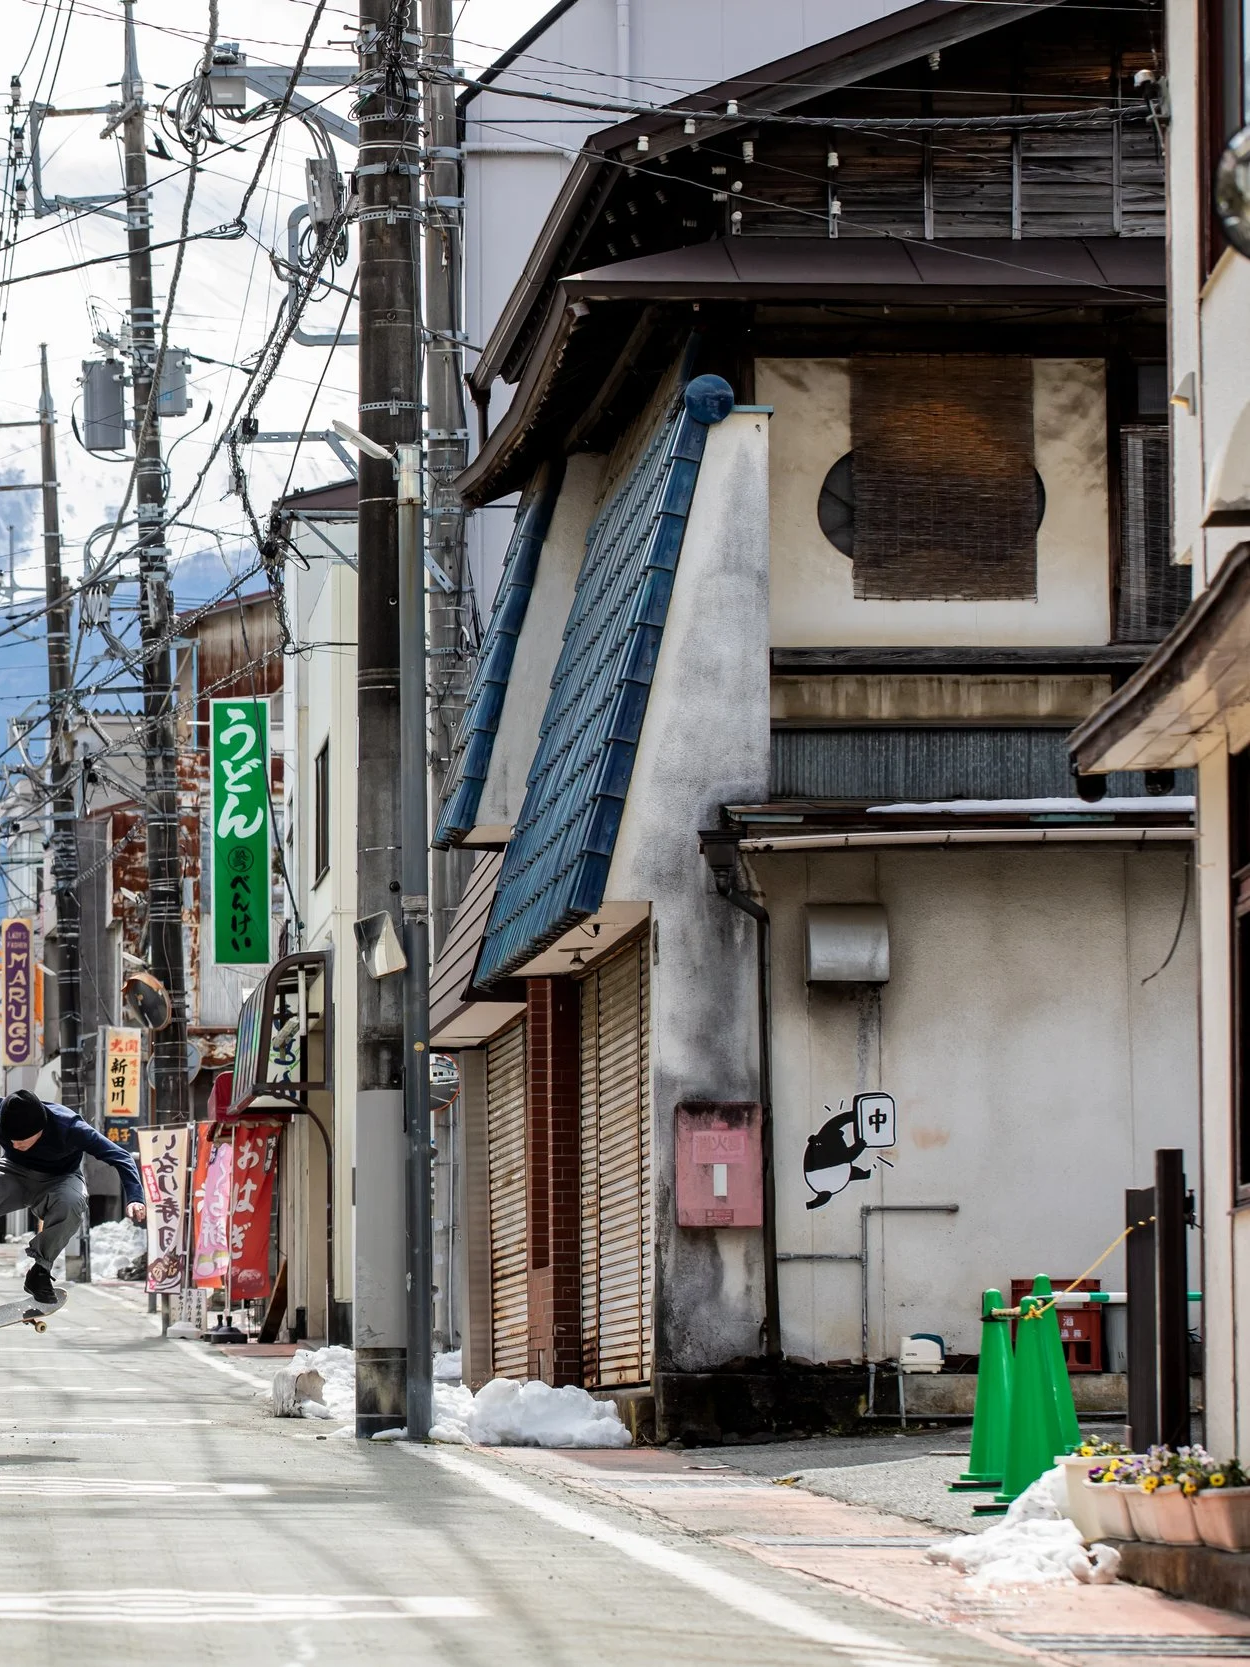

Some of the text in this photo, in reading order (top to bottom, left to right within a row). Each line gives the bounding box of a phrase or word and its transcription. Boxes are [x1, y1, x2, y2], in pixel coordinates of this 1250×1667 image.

[217, 708, 264, 839] うどん
[231, 875, 252, 952] べんけい
[110, 1039, 138, 1053] 大関
[111, 1058, 128, 1107] 新田川
[868, 1108, 887, 1133] 中
[231, 1137, 264, 1260] おはぎ
